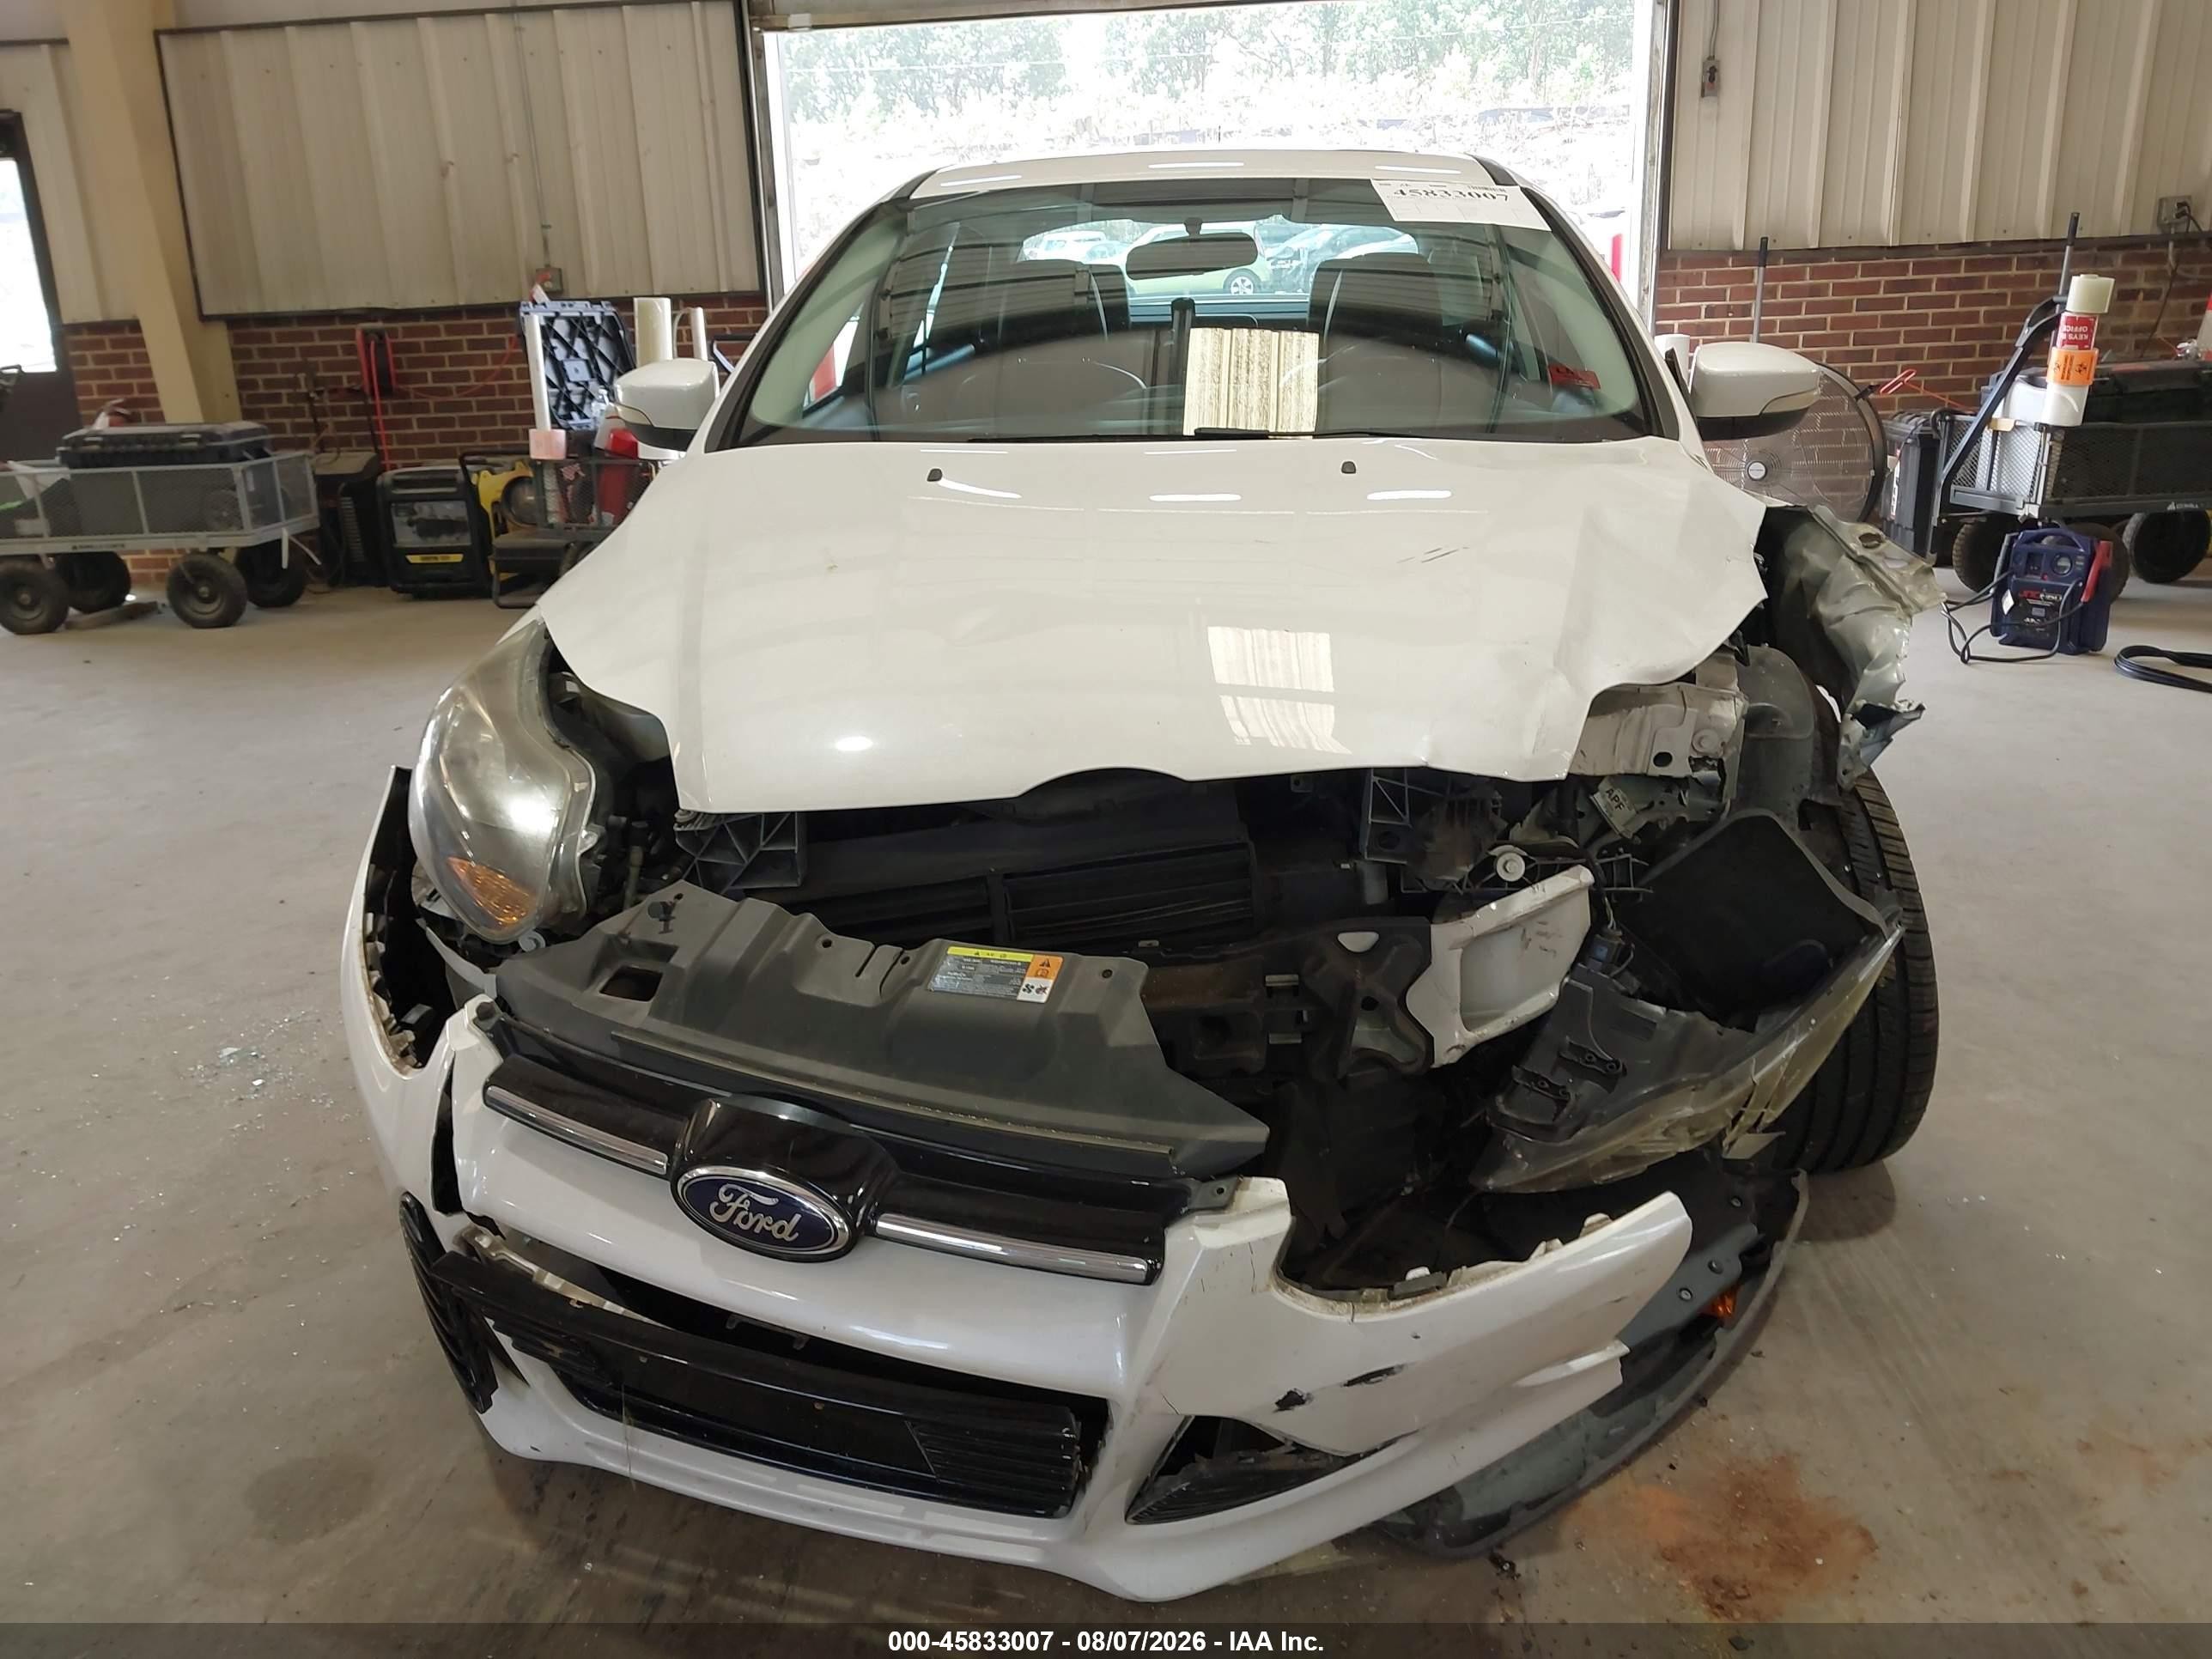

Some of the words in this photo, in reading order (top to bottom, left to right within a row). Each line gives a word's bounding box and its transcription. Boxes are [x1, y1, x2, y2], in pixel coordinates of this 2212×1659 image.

[1394, 188, 1509, 202] 45833007
[1605, 787, 1626, 811] APF
[710, 1183, 801, 1242] Ford
